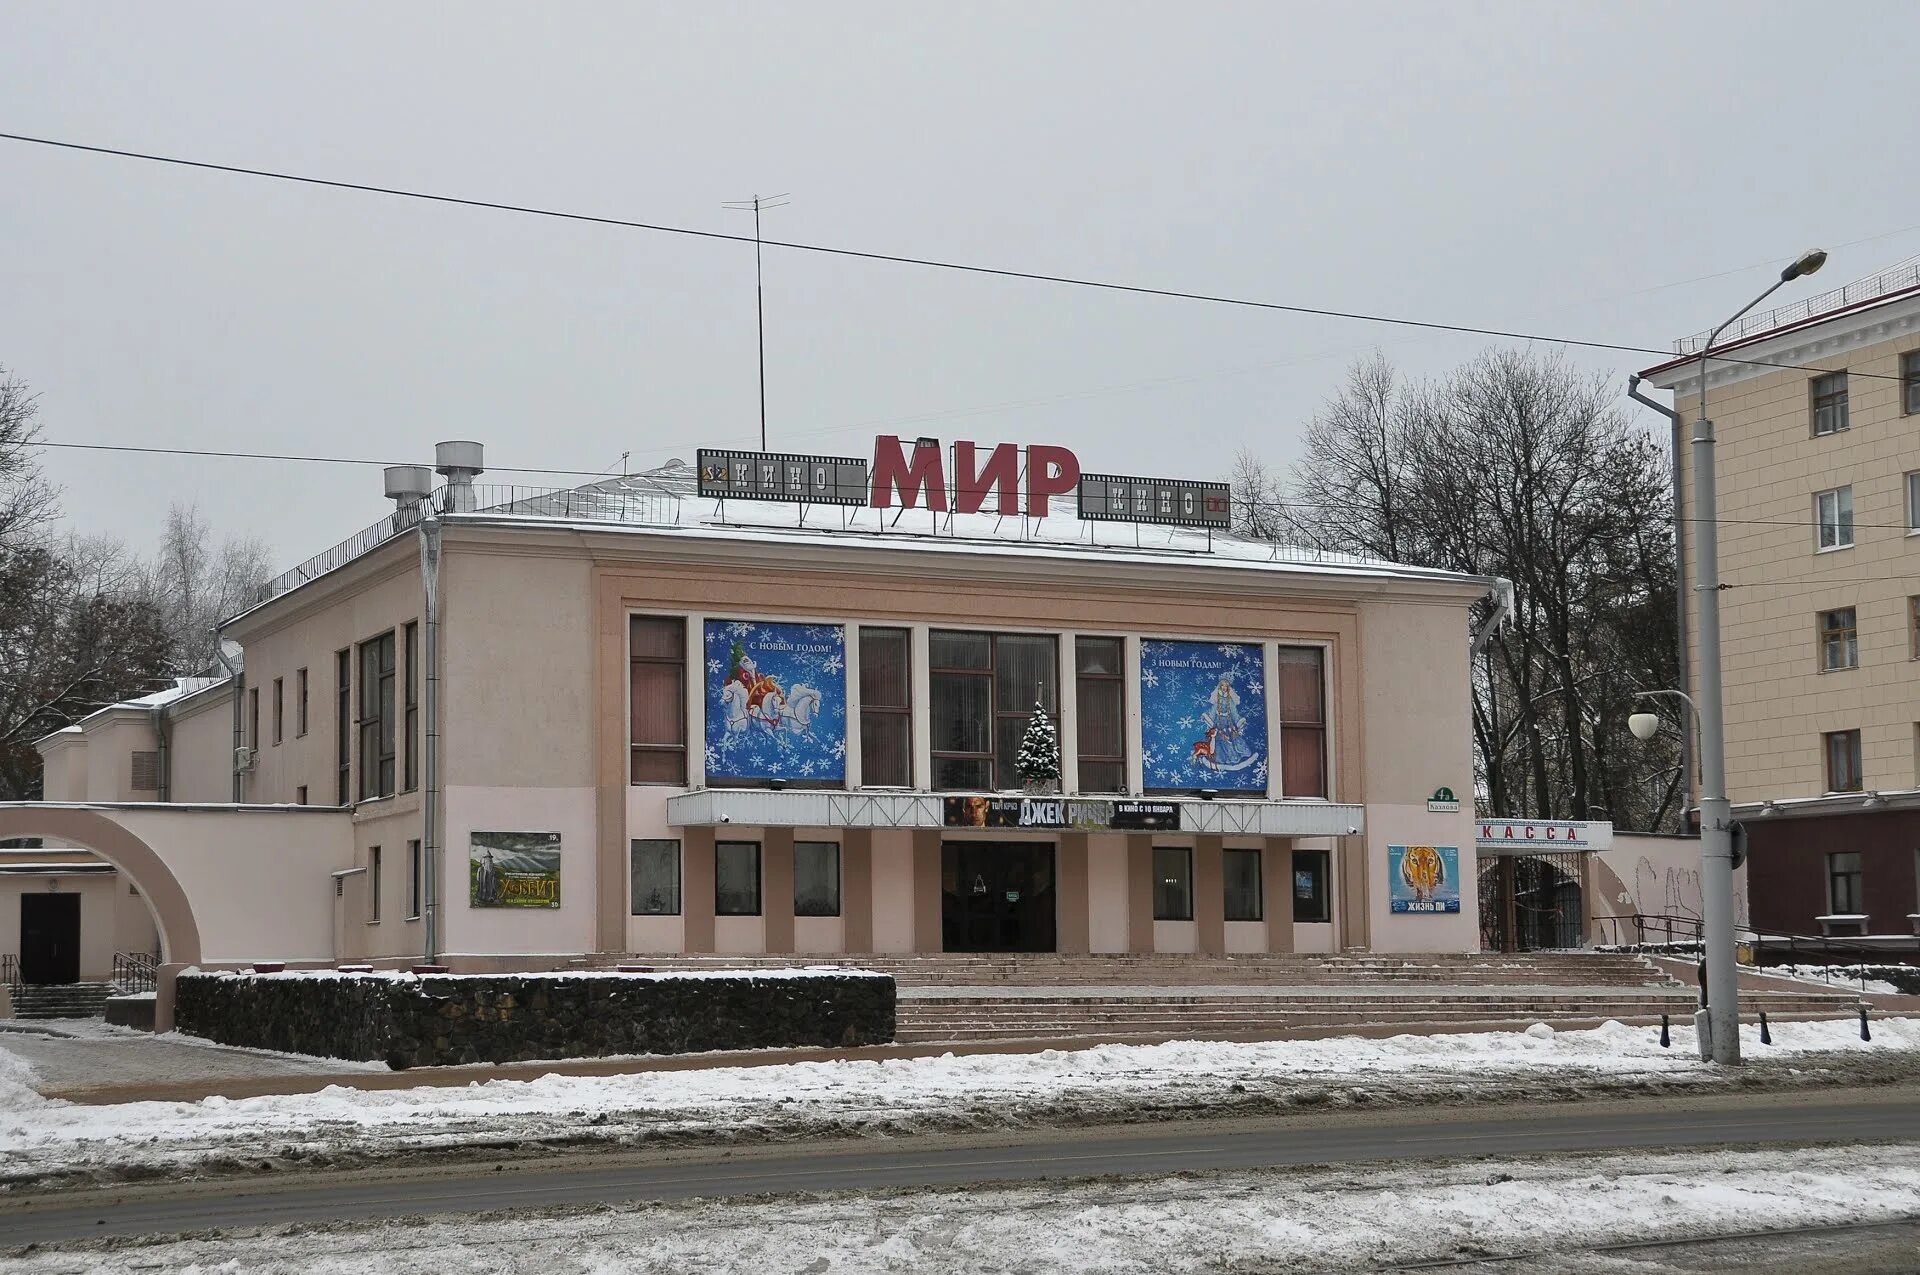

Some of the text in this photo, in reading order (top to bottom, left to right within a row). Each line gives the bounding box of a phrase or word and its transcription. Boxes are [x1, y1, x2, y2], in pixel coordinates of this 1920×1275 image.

[734, 463, 828, 491] КИНО
[870, 434, 1080, 518] МИР
[1112, 487, 1195, 515] КИНО
[749, 641, 832, 653] С НОВЫМ ГОДОМ!
[1158, 659, 1190, 668] НОВЫМ
[1190, 660, 1222, 669] ГОДАМ!
[1018, 799, 1115, 826] ДЖЕК РИЧЕР
[1118, 804, 1123, 813] В
[1124, 805, 1138, 813] КИНО
[1139, 805, 1144, 813] С
[1145, 805, 1152, 813] 10
[1482, 825, 1577, 840] КАССА
[1407, 901, 1435, 912] ЖИЗНЬ
